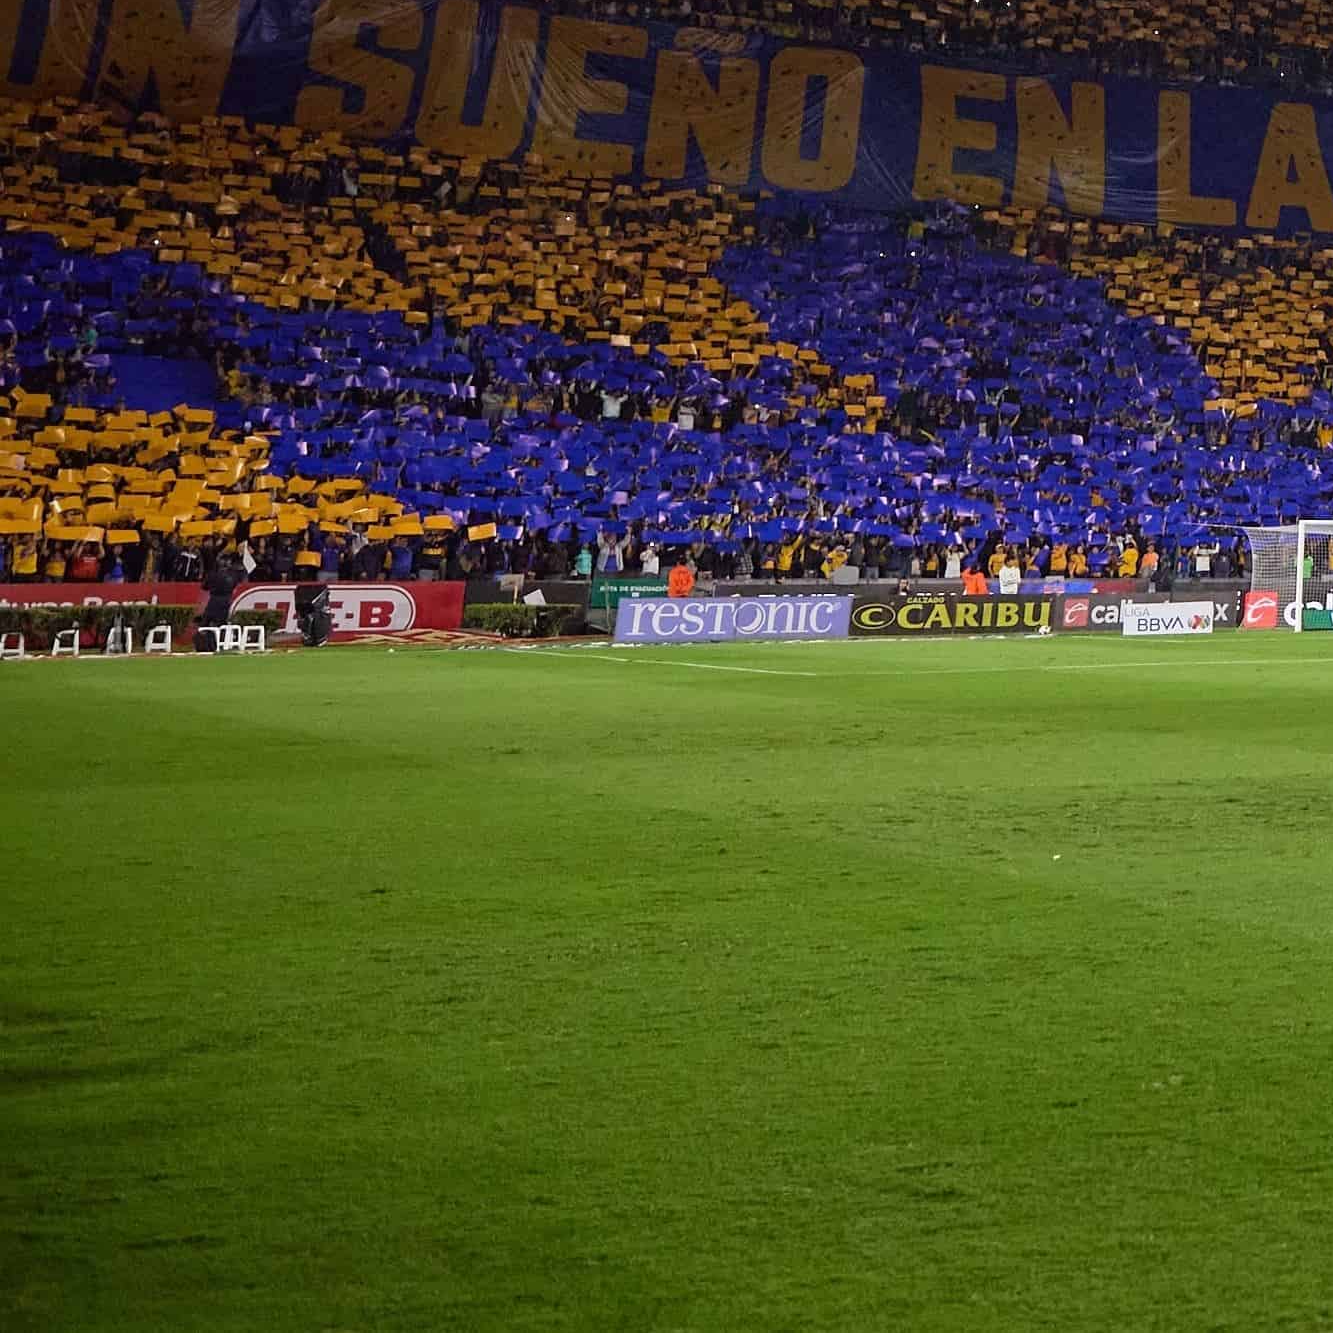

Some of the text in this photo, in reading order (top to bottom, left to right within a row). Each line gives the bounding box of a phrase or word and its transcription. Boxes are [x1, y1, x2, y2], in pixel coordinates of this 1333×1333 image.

[912, 63, 1106, 217] EN
[1125, 607, 1151, 617] LIGA
[1137, 617, 1184, 633] BBVA
